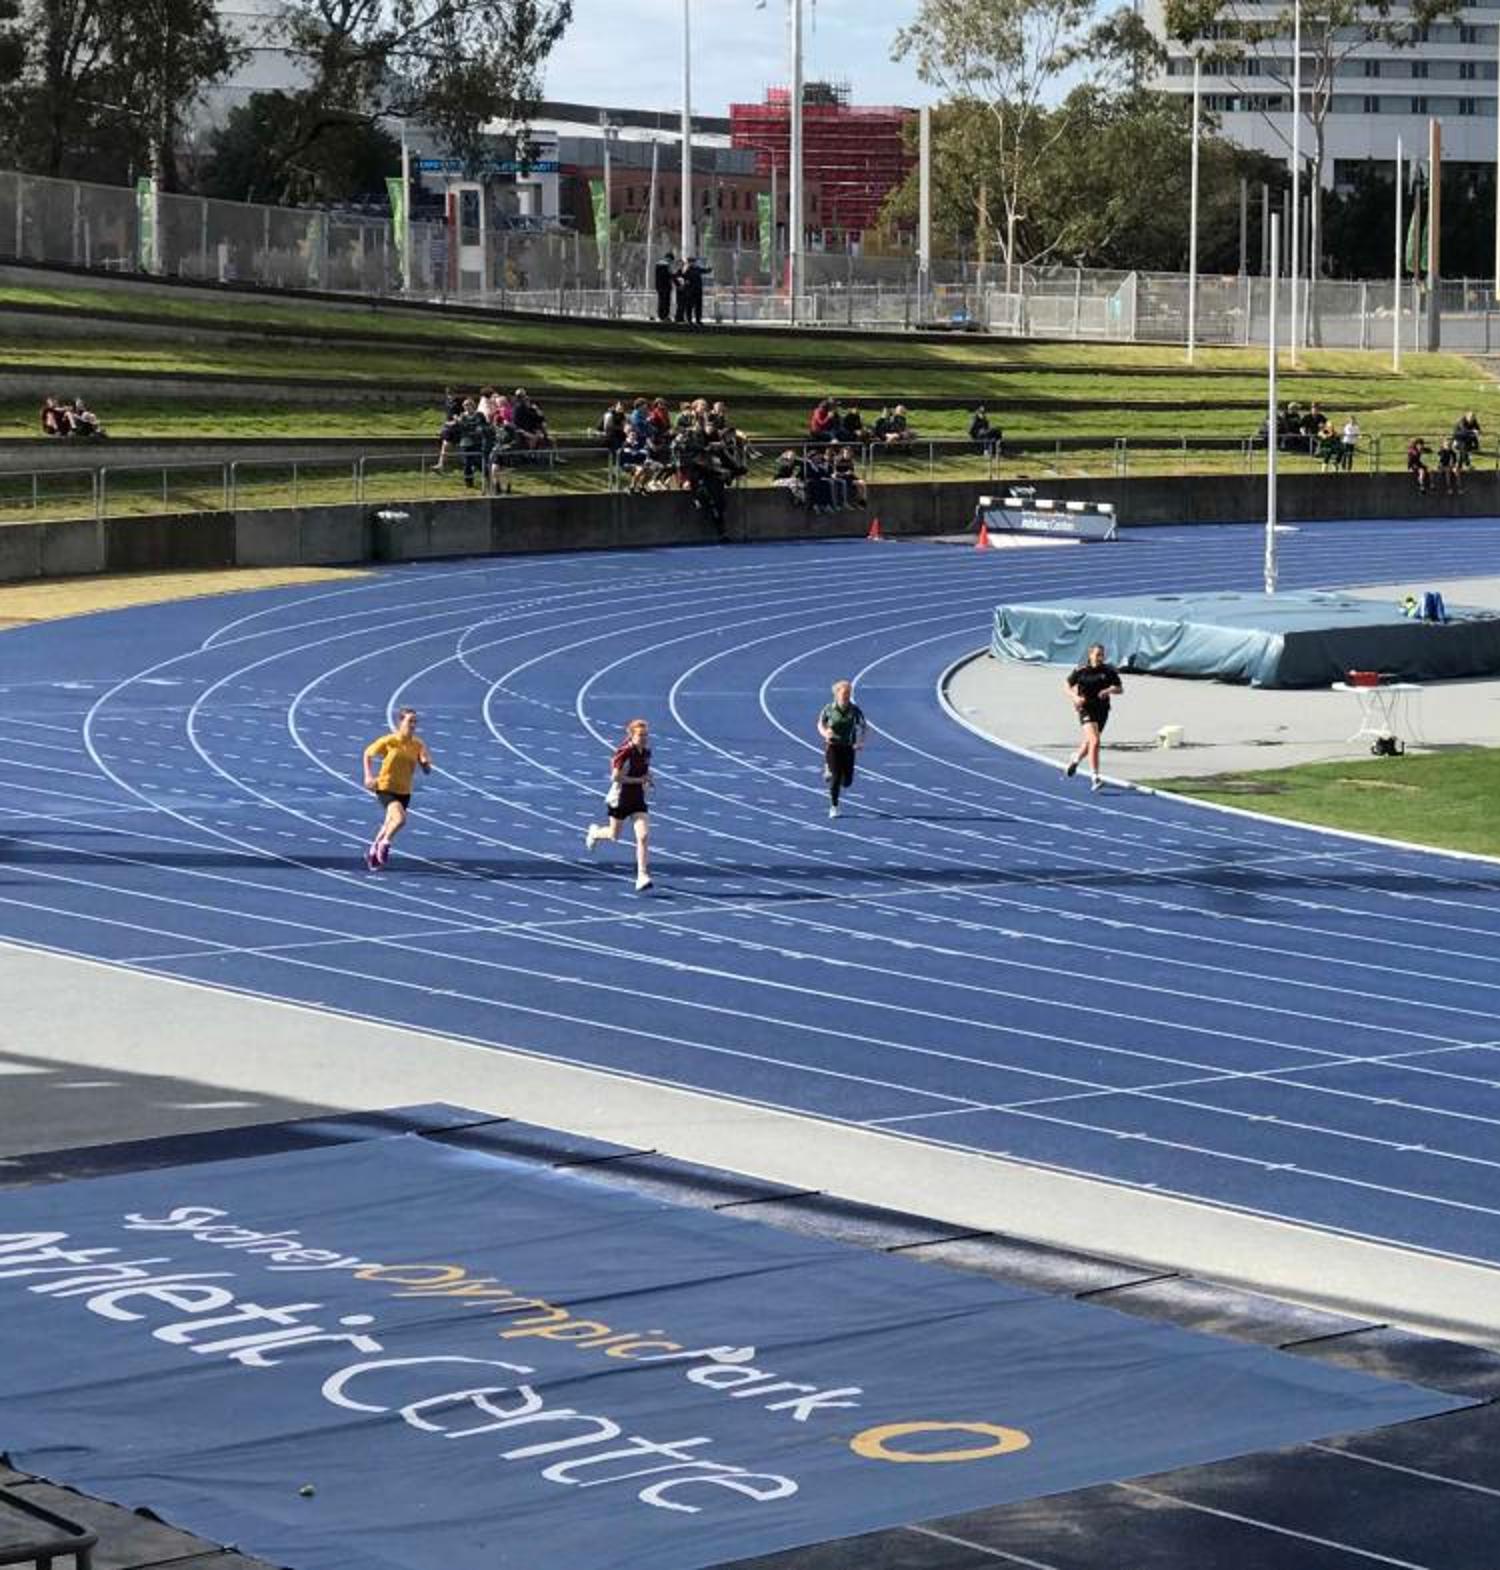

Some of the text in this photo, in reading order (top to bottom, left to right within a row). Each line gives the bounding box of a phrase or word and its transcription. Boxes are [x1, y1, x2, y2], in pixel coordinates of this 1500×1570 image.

[124, 1206, 862, 1422] Sydney Olympic Park
[321, 1356, 799, 1513] Centre
